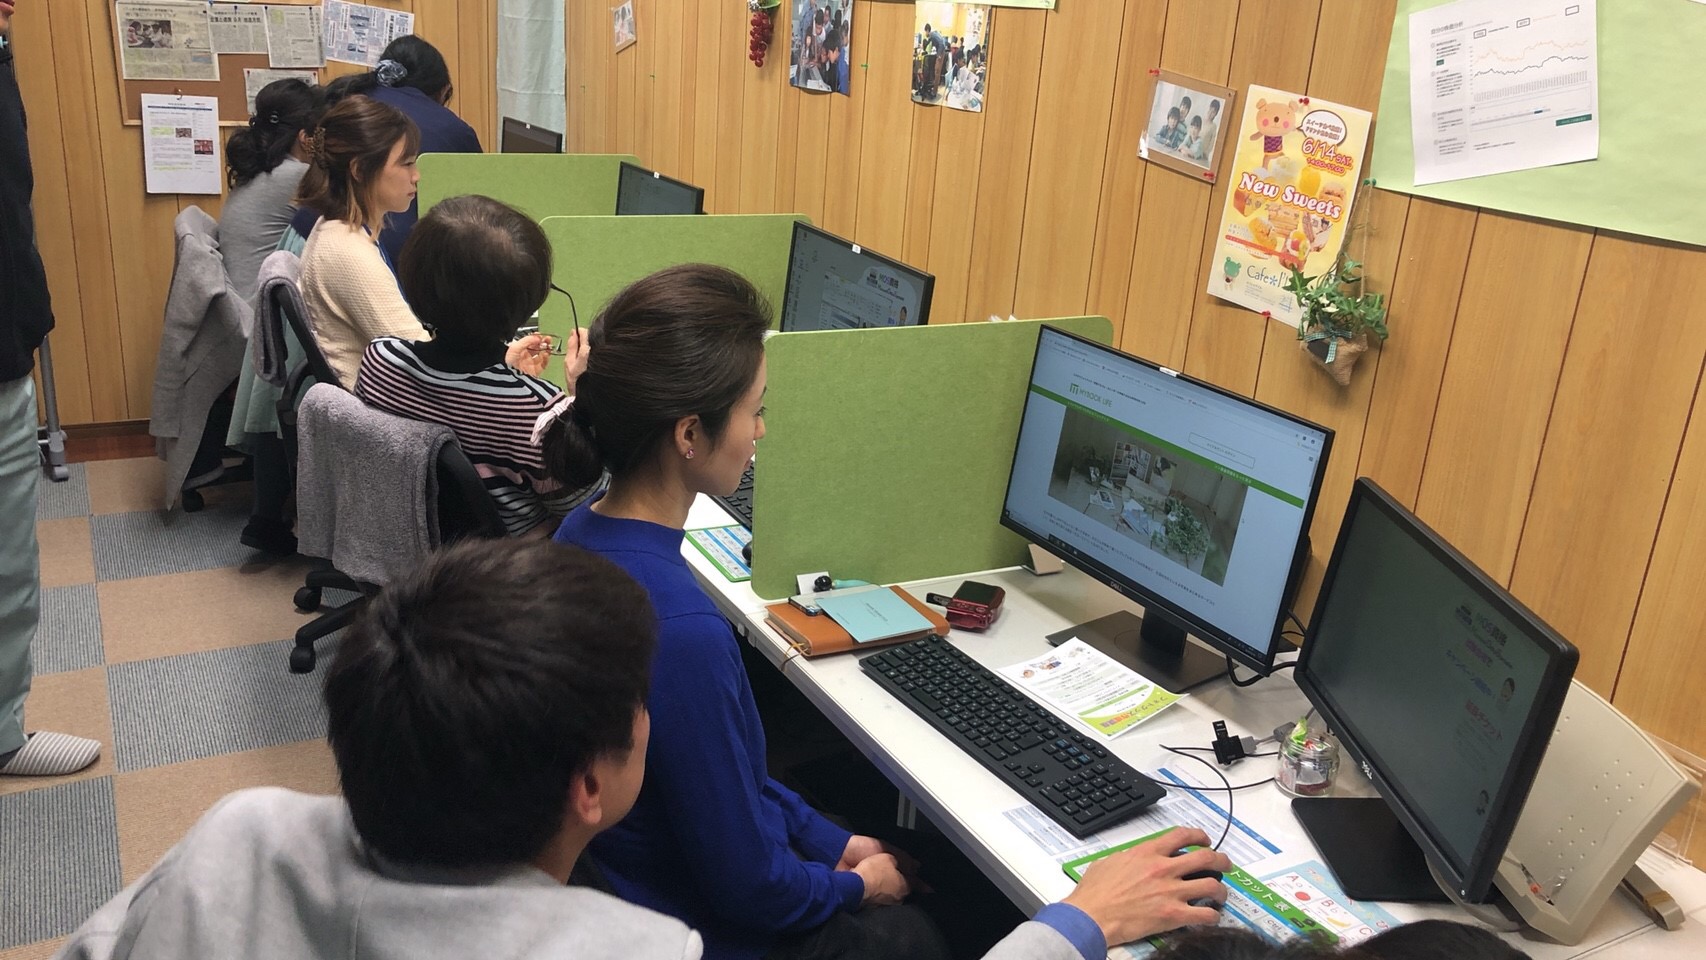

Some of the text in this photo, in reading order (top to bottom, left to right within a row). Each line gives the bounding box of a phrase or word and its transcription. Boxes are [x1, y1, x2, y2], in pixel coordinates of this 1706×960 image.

[1302, 138, 1336, 161] 6/14
[1239, 172, 1342, 219] New Sweets
[1110, 581, 1123, 593] DELL
